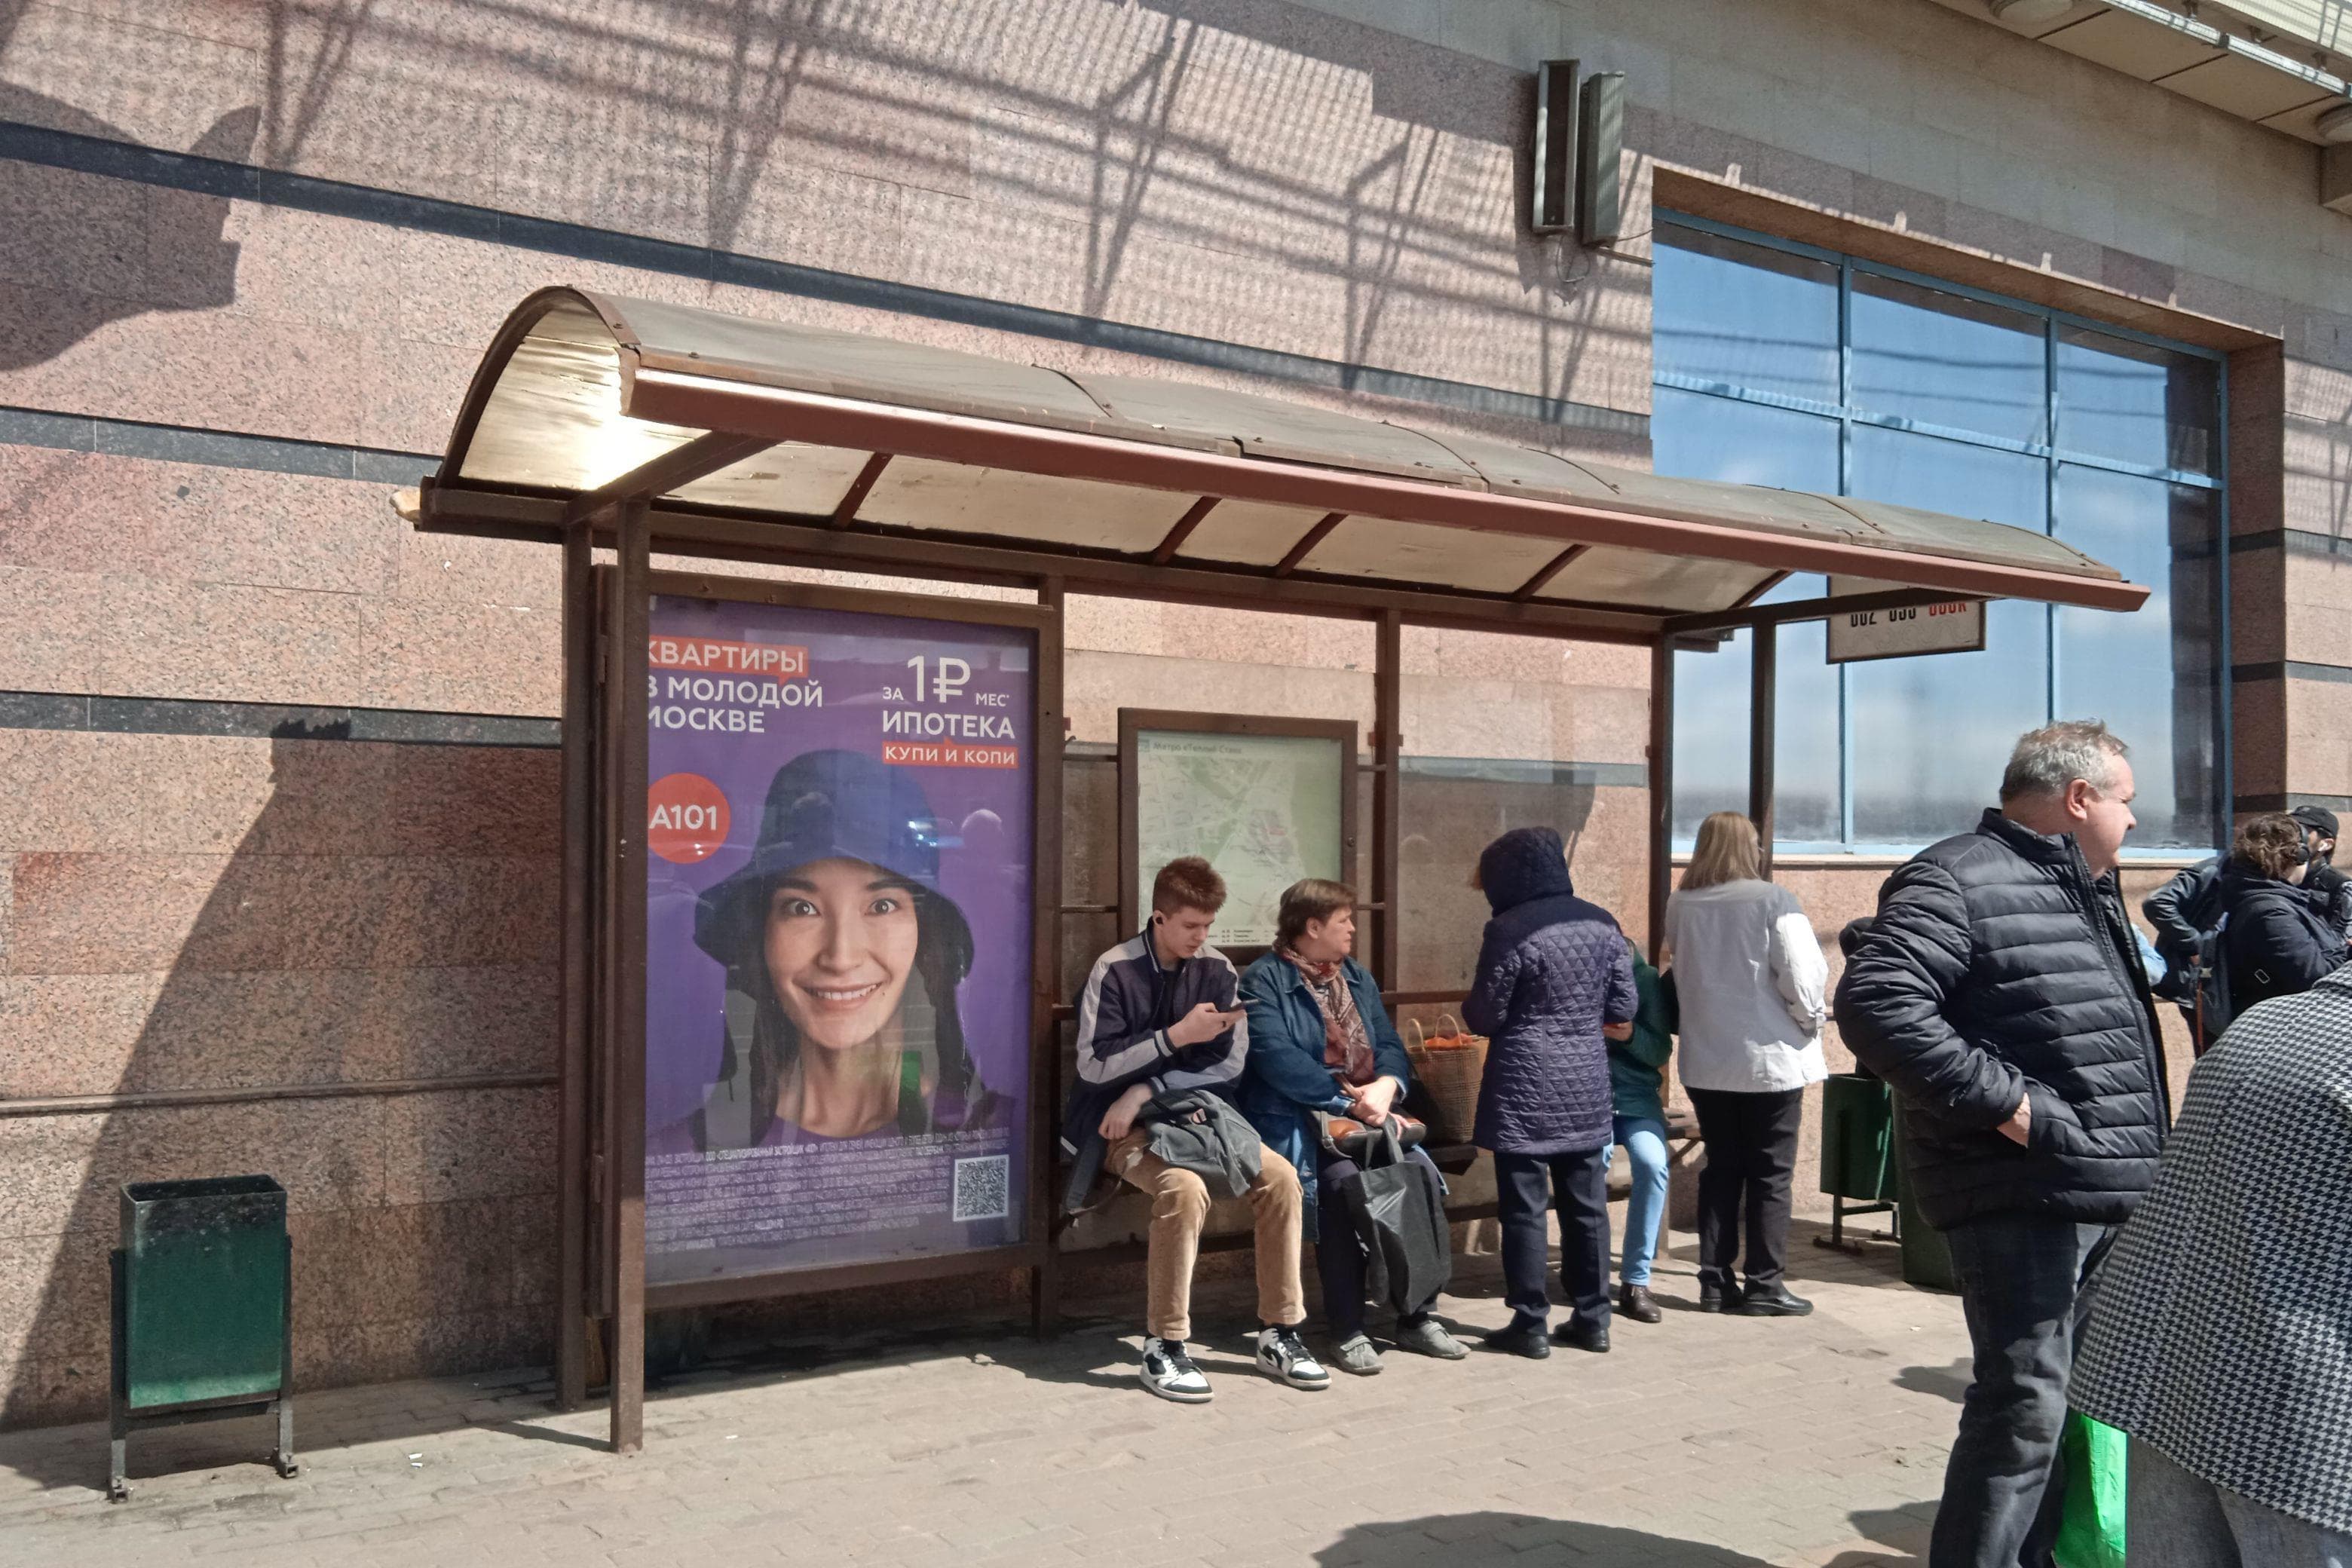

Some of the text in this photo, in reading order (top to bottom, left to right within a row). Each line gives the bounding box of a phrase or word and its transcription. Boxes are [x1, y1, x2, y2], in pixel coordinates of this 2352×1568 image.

[649, 641, 803, 673] КВАРТИРЫ
[668, 676, 823, 709] МОЛОДОЙ
[883, 686, 905, 701] ЗА
[883, 709, 1016, 740] ИПОТЕКА
[885, 746, 1015, 765] КУПИ И КОПИ
[648, 804, 717, 831] А101
